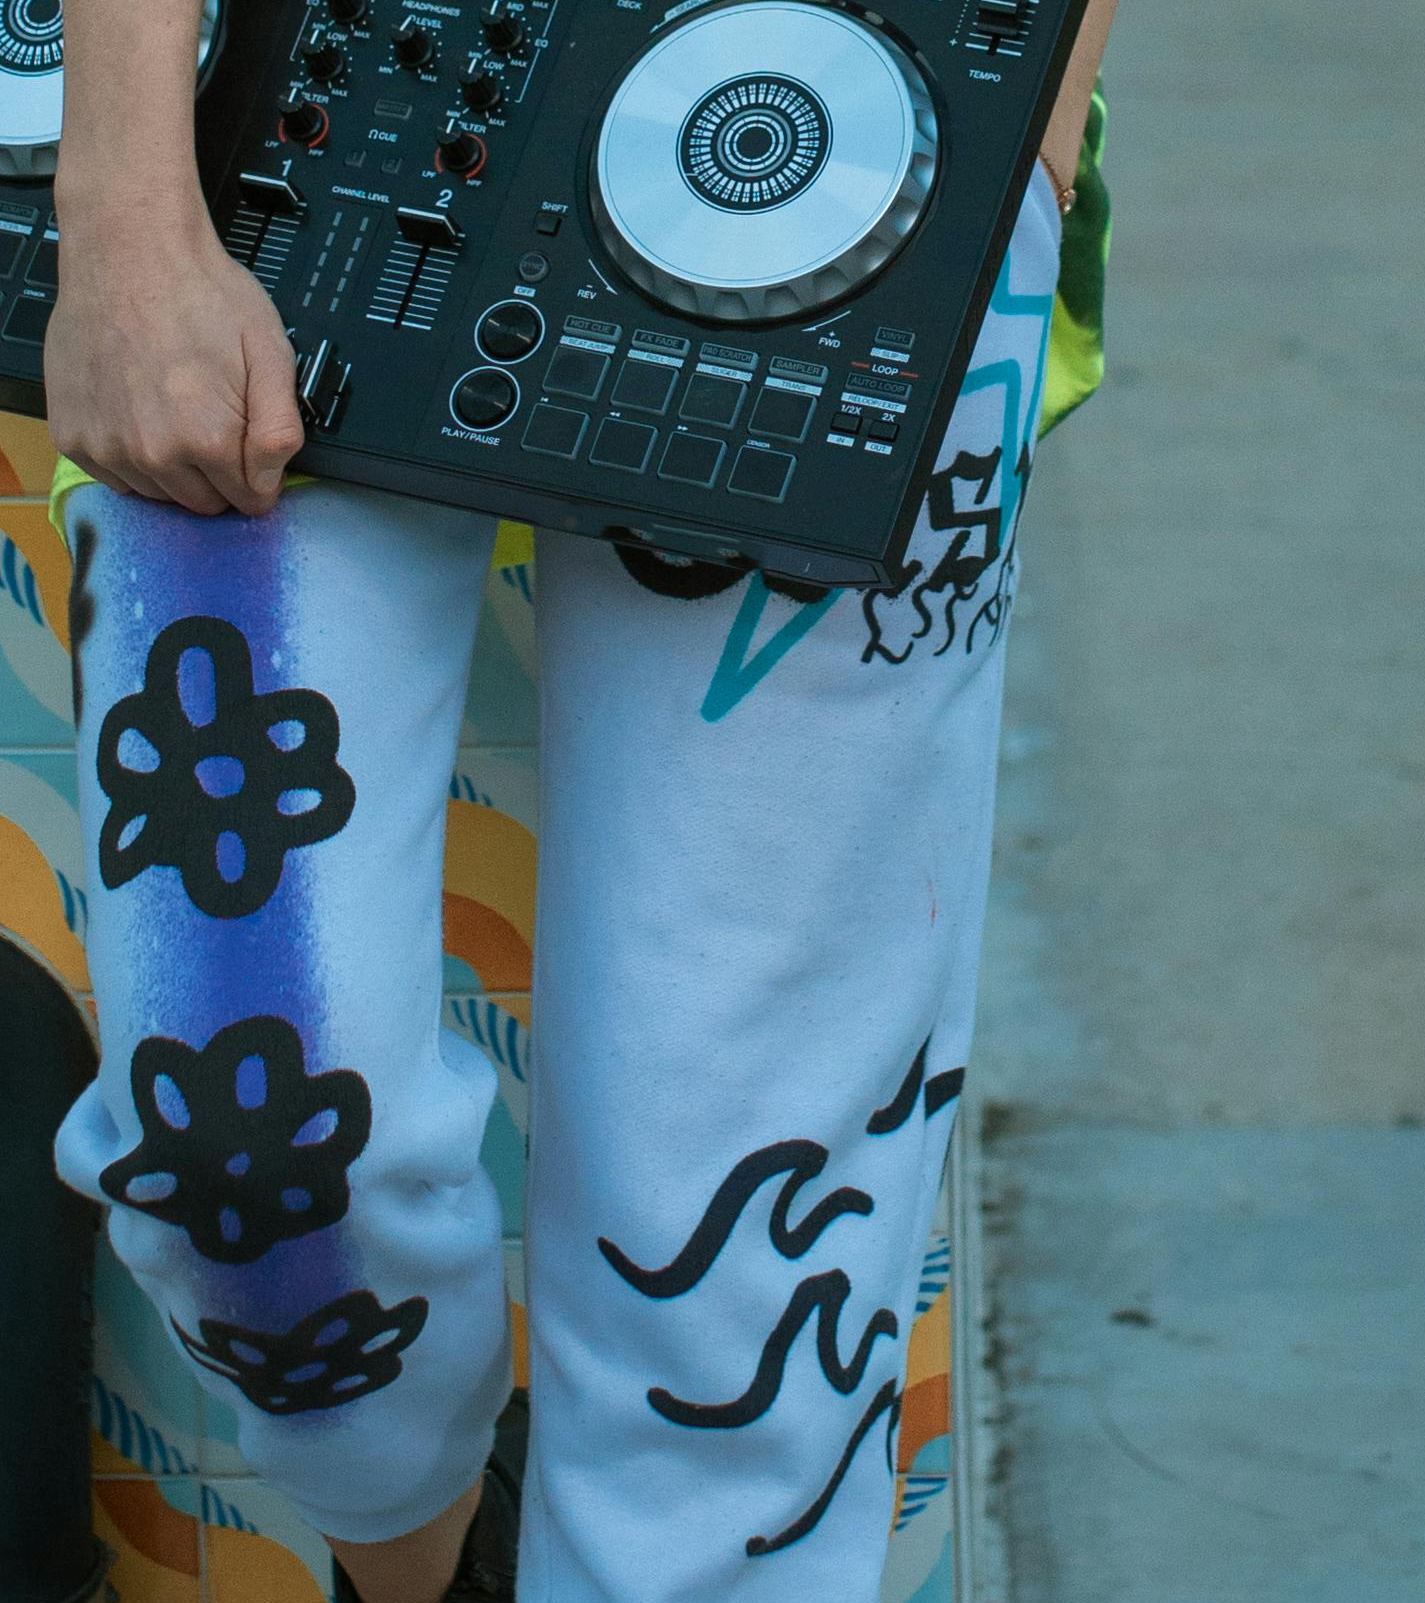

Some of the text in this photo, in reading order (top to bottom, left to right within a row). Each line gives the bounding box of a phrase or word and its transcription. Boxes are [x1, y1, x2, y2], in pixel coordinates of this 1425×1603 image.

[401, 0, 461, 18] HEADPHONES
[507, 1, 524, 11] MID
[416, 17, 443, 29] LEVEL
[326, 31, 348, 42] LOW
[353, 30, 371, 39] MAX
[378, 66, 393, 75] MIN
[483, 60, 505, 71] LOW
[420, 74, 438, 83] MAX
[968, 69, 1001, 82] TEMPO
[331, 87, 348, 97] MAX
[488, 118, 506, 127] MAX
[378, 132, 398, 142] CUE
[282, 159, 292, 177] 1
[331, 185, 390, 204] CHANNEL LEVEL
[435, 189, 453, 208] 2
[541, 201, 568, 213] SHIFT
[577, 289, 597, 300] REV
[570, 319, 612, 334] HOT CUE
[640, 333, 680, 348] FX FADE
[818, 337, 841, 348] FWD
[719, 348, 752, 362] SCRATCH
[775, 359, 820, 376] SAMPLER
[872, 364, 899, 376] LOOP
[851, 377, 906, 393] AUTO LOOP
[841, 404, 862, 415] 1/2X
[882, 413, 896, 422] 2X
[441, 426, 501, 446] PLAY/PAUSE
